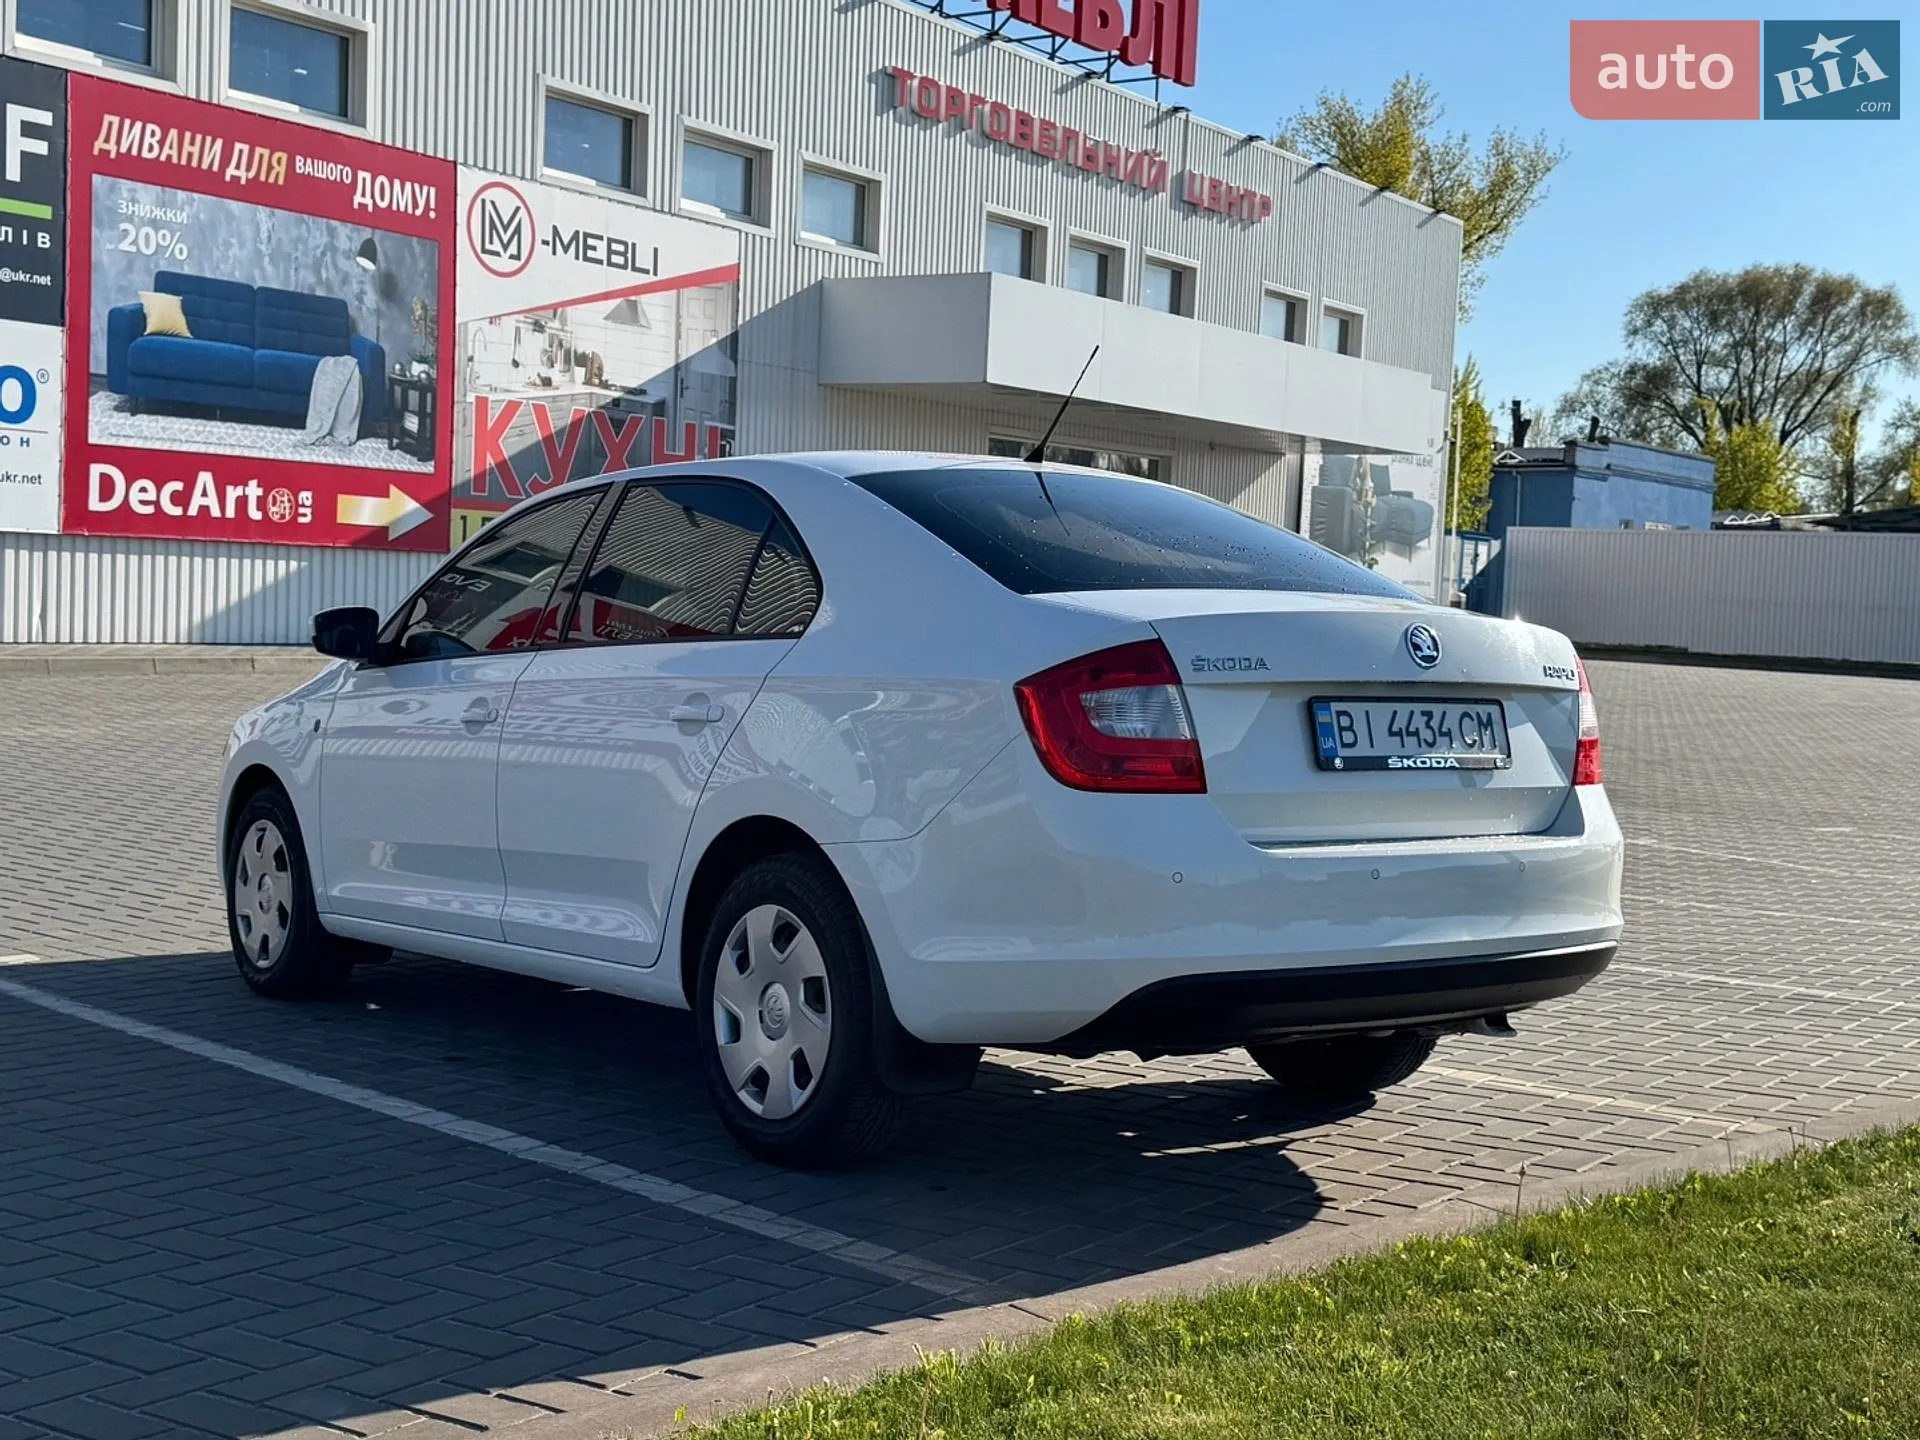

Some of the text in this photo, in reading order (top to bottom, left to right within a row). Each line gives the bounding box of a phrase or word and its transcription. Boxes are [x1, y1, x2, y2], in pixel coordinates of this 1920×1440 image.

[5, 102, 54, 182] F
[886, 65, 1272, 223] ТОРГОВЕЛЬНИЙ ЦЕНТР
[93, 114, 437, 219] ДИВАНИ ДЛЯ ВАШОГО ДОМУ!
[118, 223, 188, 260] 20%
[88, 463, 264, 521] DecArt
[1190, 654, 1273, 673] ŠKODA
[1321, 737, 1336, 750] UA
[1335, 709, 1498, 751] BI 4434 CM
[1387, 756, 1460, 769] ŠKODA
